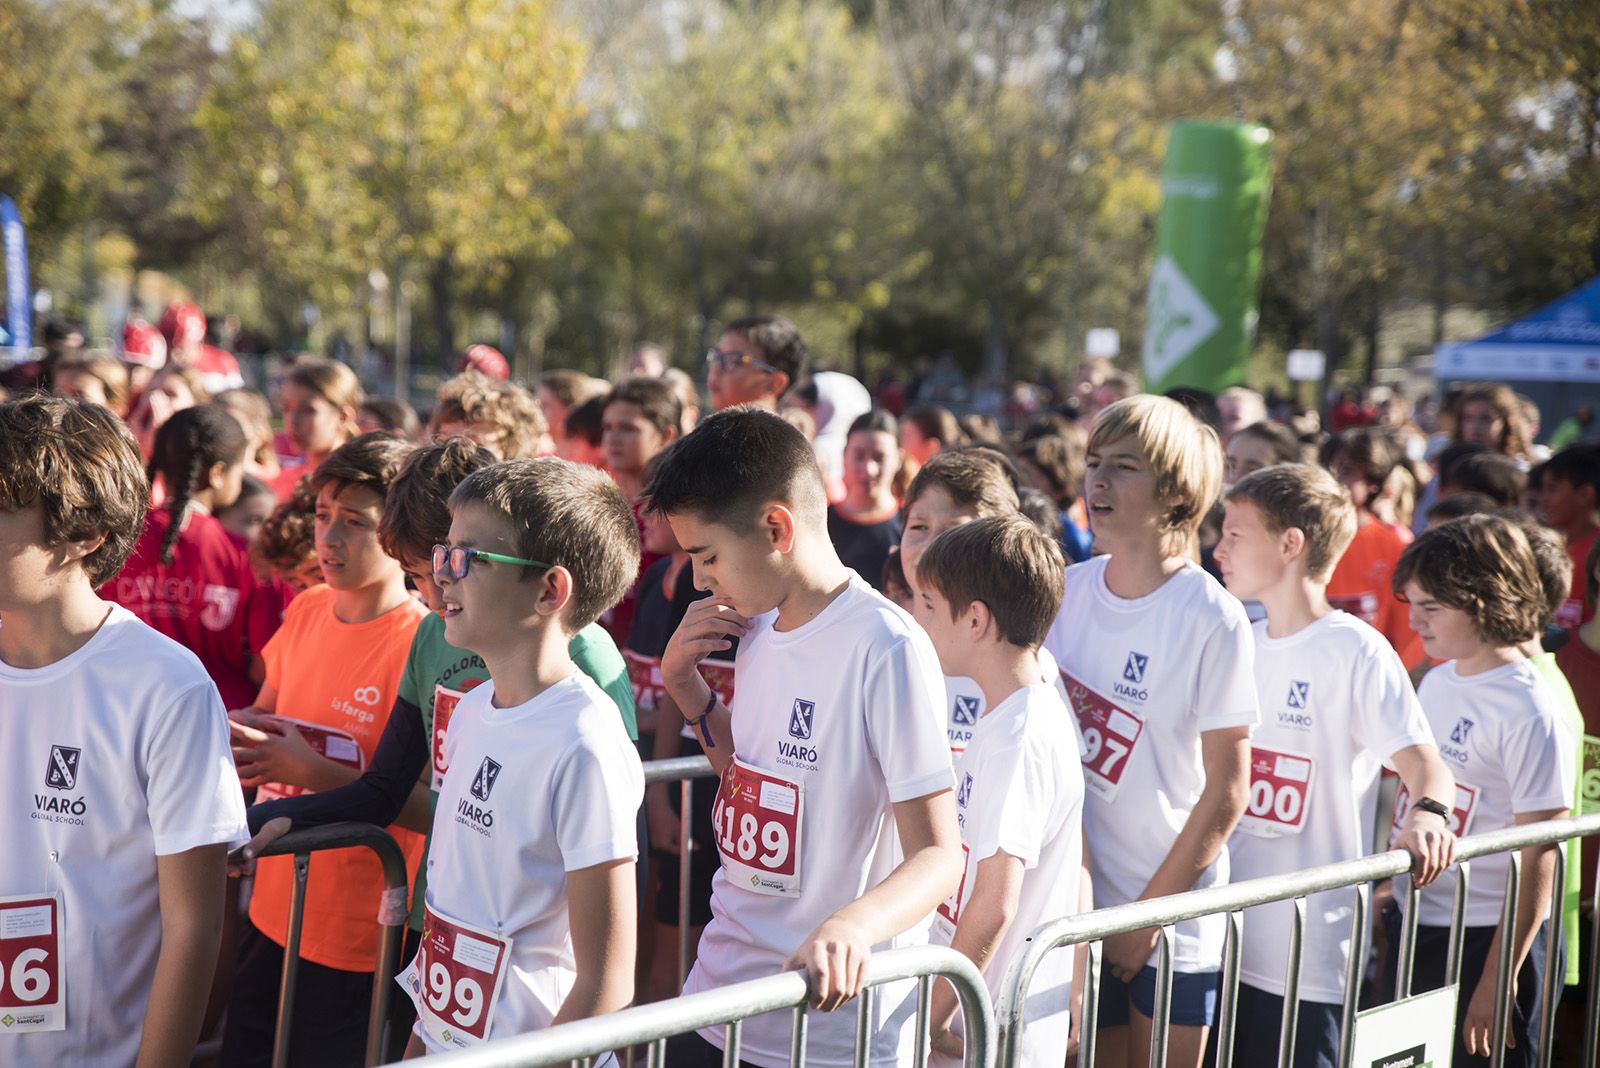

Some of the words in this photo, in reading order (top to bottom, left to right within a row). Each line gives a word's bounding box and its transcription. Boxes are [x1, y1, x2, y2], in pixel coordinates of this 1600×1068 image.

[1114, 682, 1148, 701] VIARÓ
[341, 701, 375, 723] farga
[779, 741, 817, 763] VIARÓ
[776, 757, 794, 767] GLOBAL
[795, 761, 818, 771] SCHOOL
[35, 794, 86, 816] VIARÓ
[458, 797, 493, 827] VIARÓ
[55, 816, 85, 826] SCHOOL
[714, 798, 790, 868] 4189
[0, 948, 51, 1002] 6
